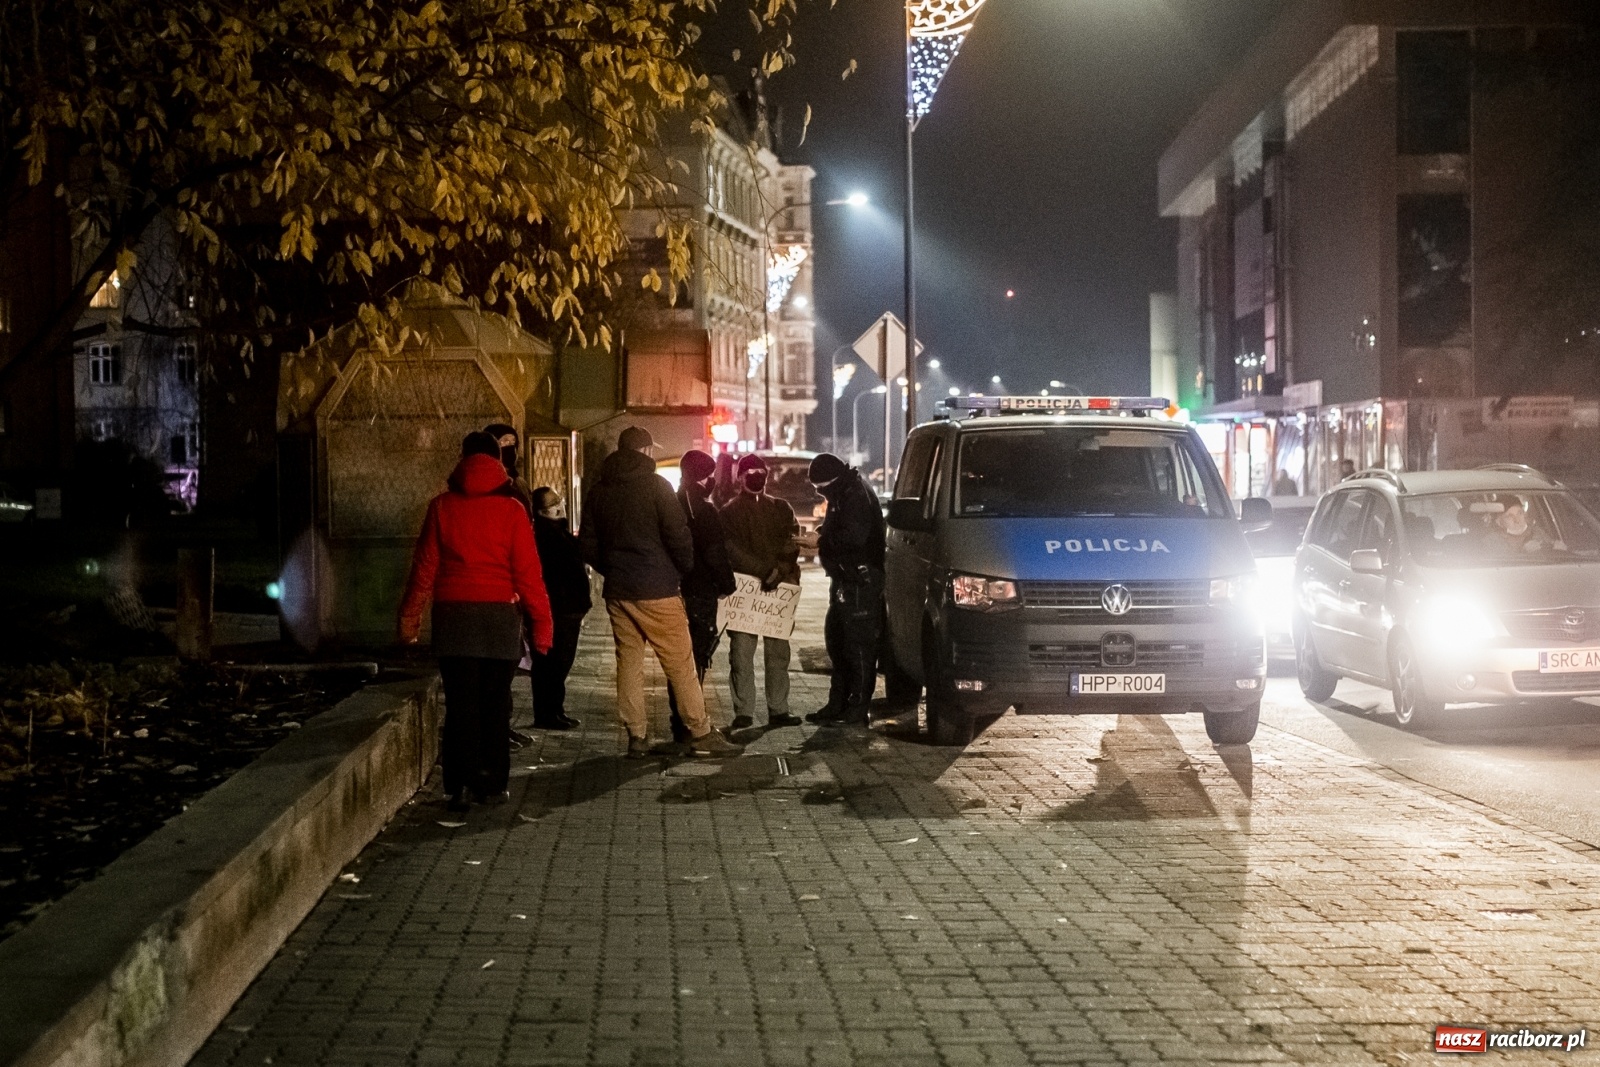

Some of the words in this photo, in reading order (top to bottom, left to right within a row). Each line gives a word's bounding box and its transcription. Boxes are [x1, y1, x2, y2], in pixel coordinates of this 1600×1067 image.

[1016, 399, 1082, 408] POLICJA
[1045, 538, 1171, 554] POLICJA
[724, 596, 745, 609] NIE
[725, 609, 737, 620] PO
[1551, 652, 1579, 668] SRC
[1082, 676, 1117, 691] HPP
[1123, 676, 1163, 691] R004
